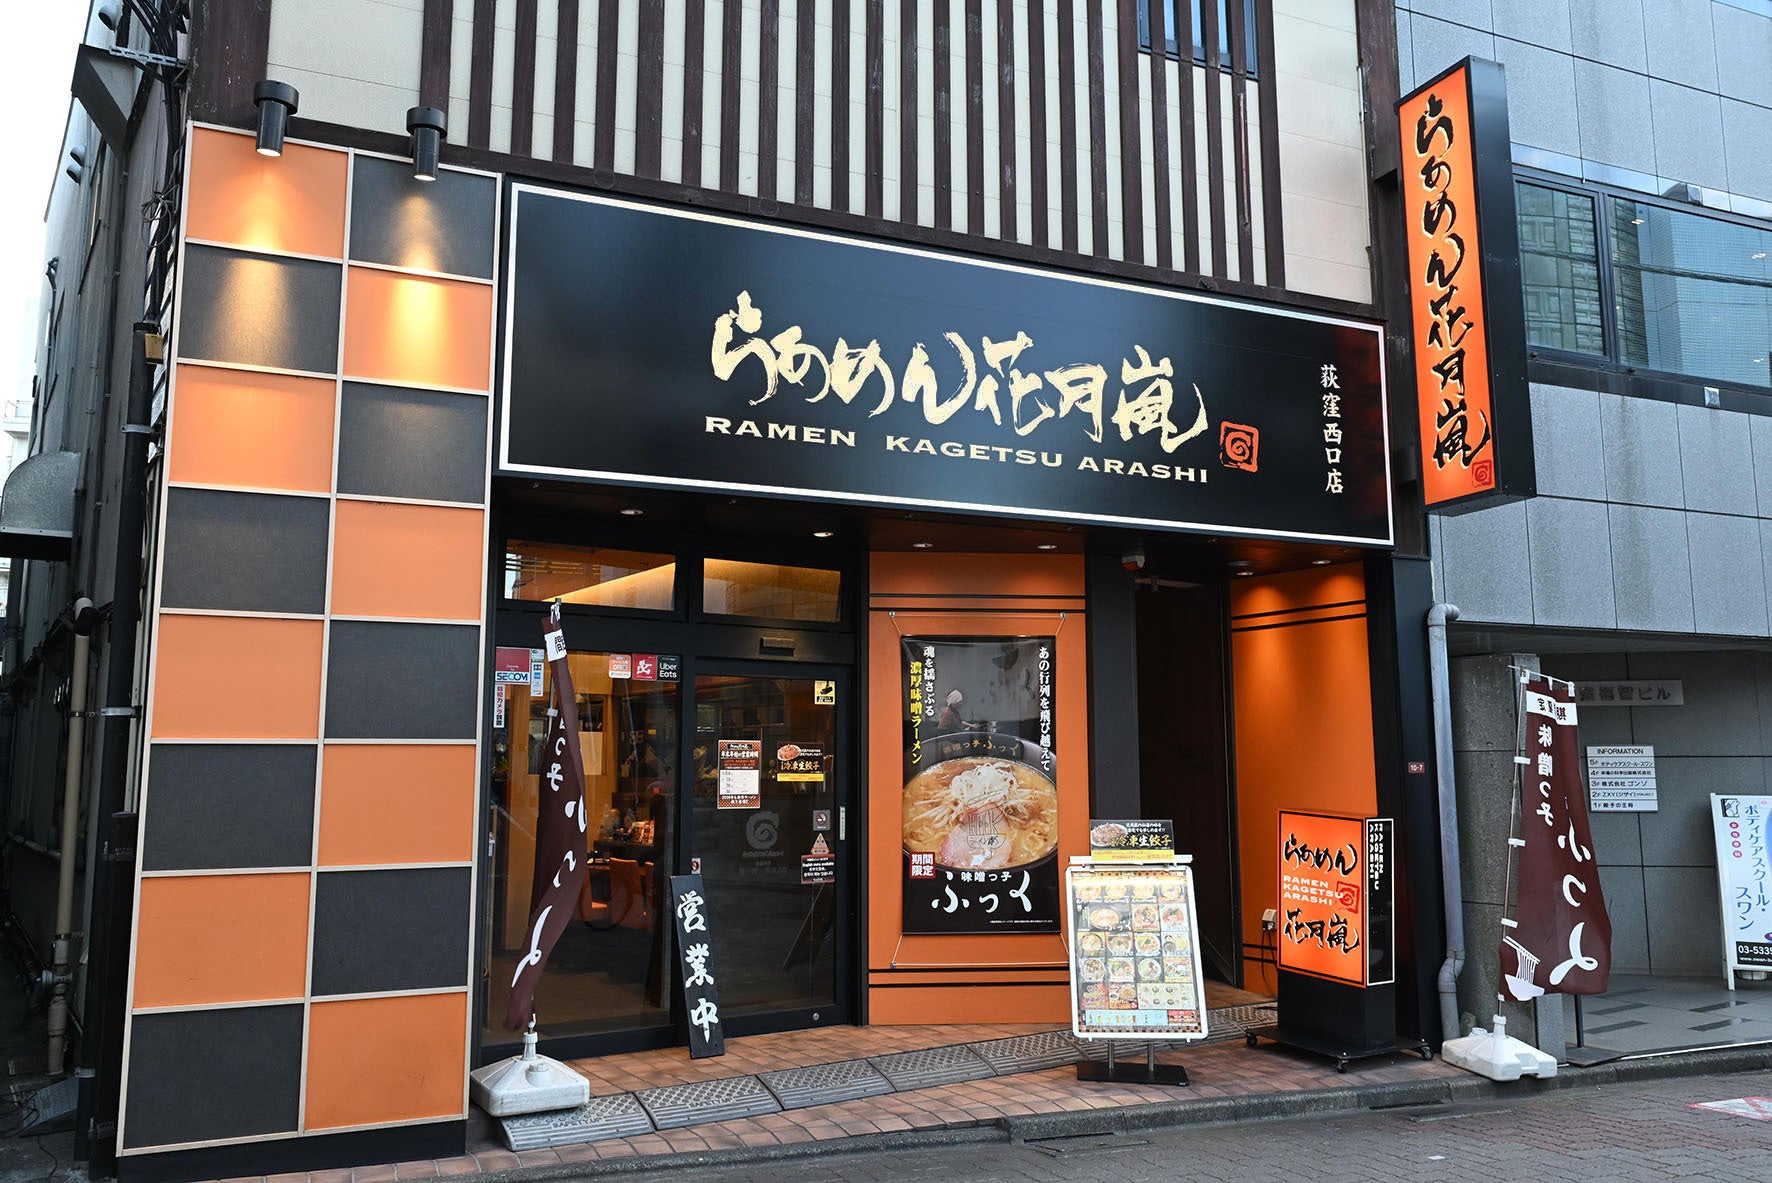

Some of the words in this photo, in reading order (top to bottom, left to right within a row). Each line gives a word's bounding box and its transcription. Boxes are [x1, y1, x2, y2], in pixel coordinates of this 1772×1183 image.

[1417, 93, 1490, 470] らあめん花月嵐
[711, 290, 1209, 455] らあめん花月嵐
[705, 415, 856, 448] RAMEN
[886, 435, 1064, 469] KAGETSU
[1078, 456, 1208, 484] ARASHI
[1319, 363, 1345, 495] 荻窪西口店
[496, 672, 528, 681] SECOM
[660, 662, 677, 671] Uber
[660, 670, 677, 678] Eats
[923, 645, 936, 717] 魂を揺さぶる
[910, 661, 923, 765] 濃厚味噌ラーメン
[1038, 646, 1051, 772] あの行列を飛び越えて
[911, 853, 934, 866] 期間
[911, 865, 934, 877] 限定
[960, 871, 1012, 882] 味噌っ子
[1283, 833, 1358, 877] らあめん
[931, 870, 1032, 914] ふっく
[1283, 875, 1328, 888] RAMEN
[1283, 883, 1344, 899] KAGETSU
[1283, 891, 1333, 906] ARASHI
[1736, 886, 1755, 930] スワン
[1283, 907, 1360, 955] 花月嵐
[677, 890, 719, 1043] 営業中
